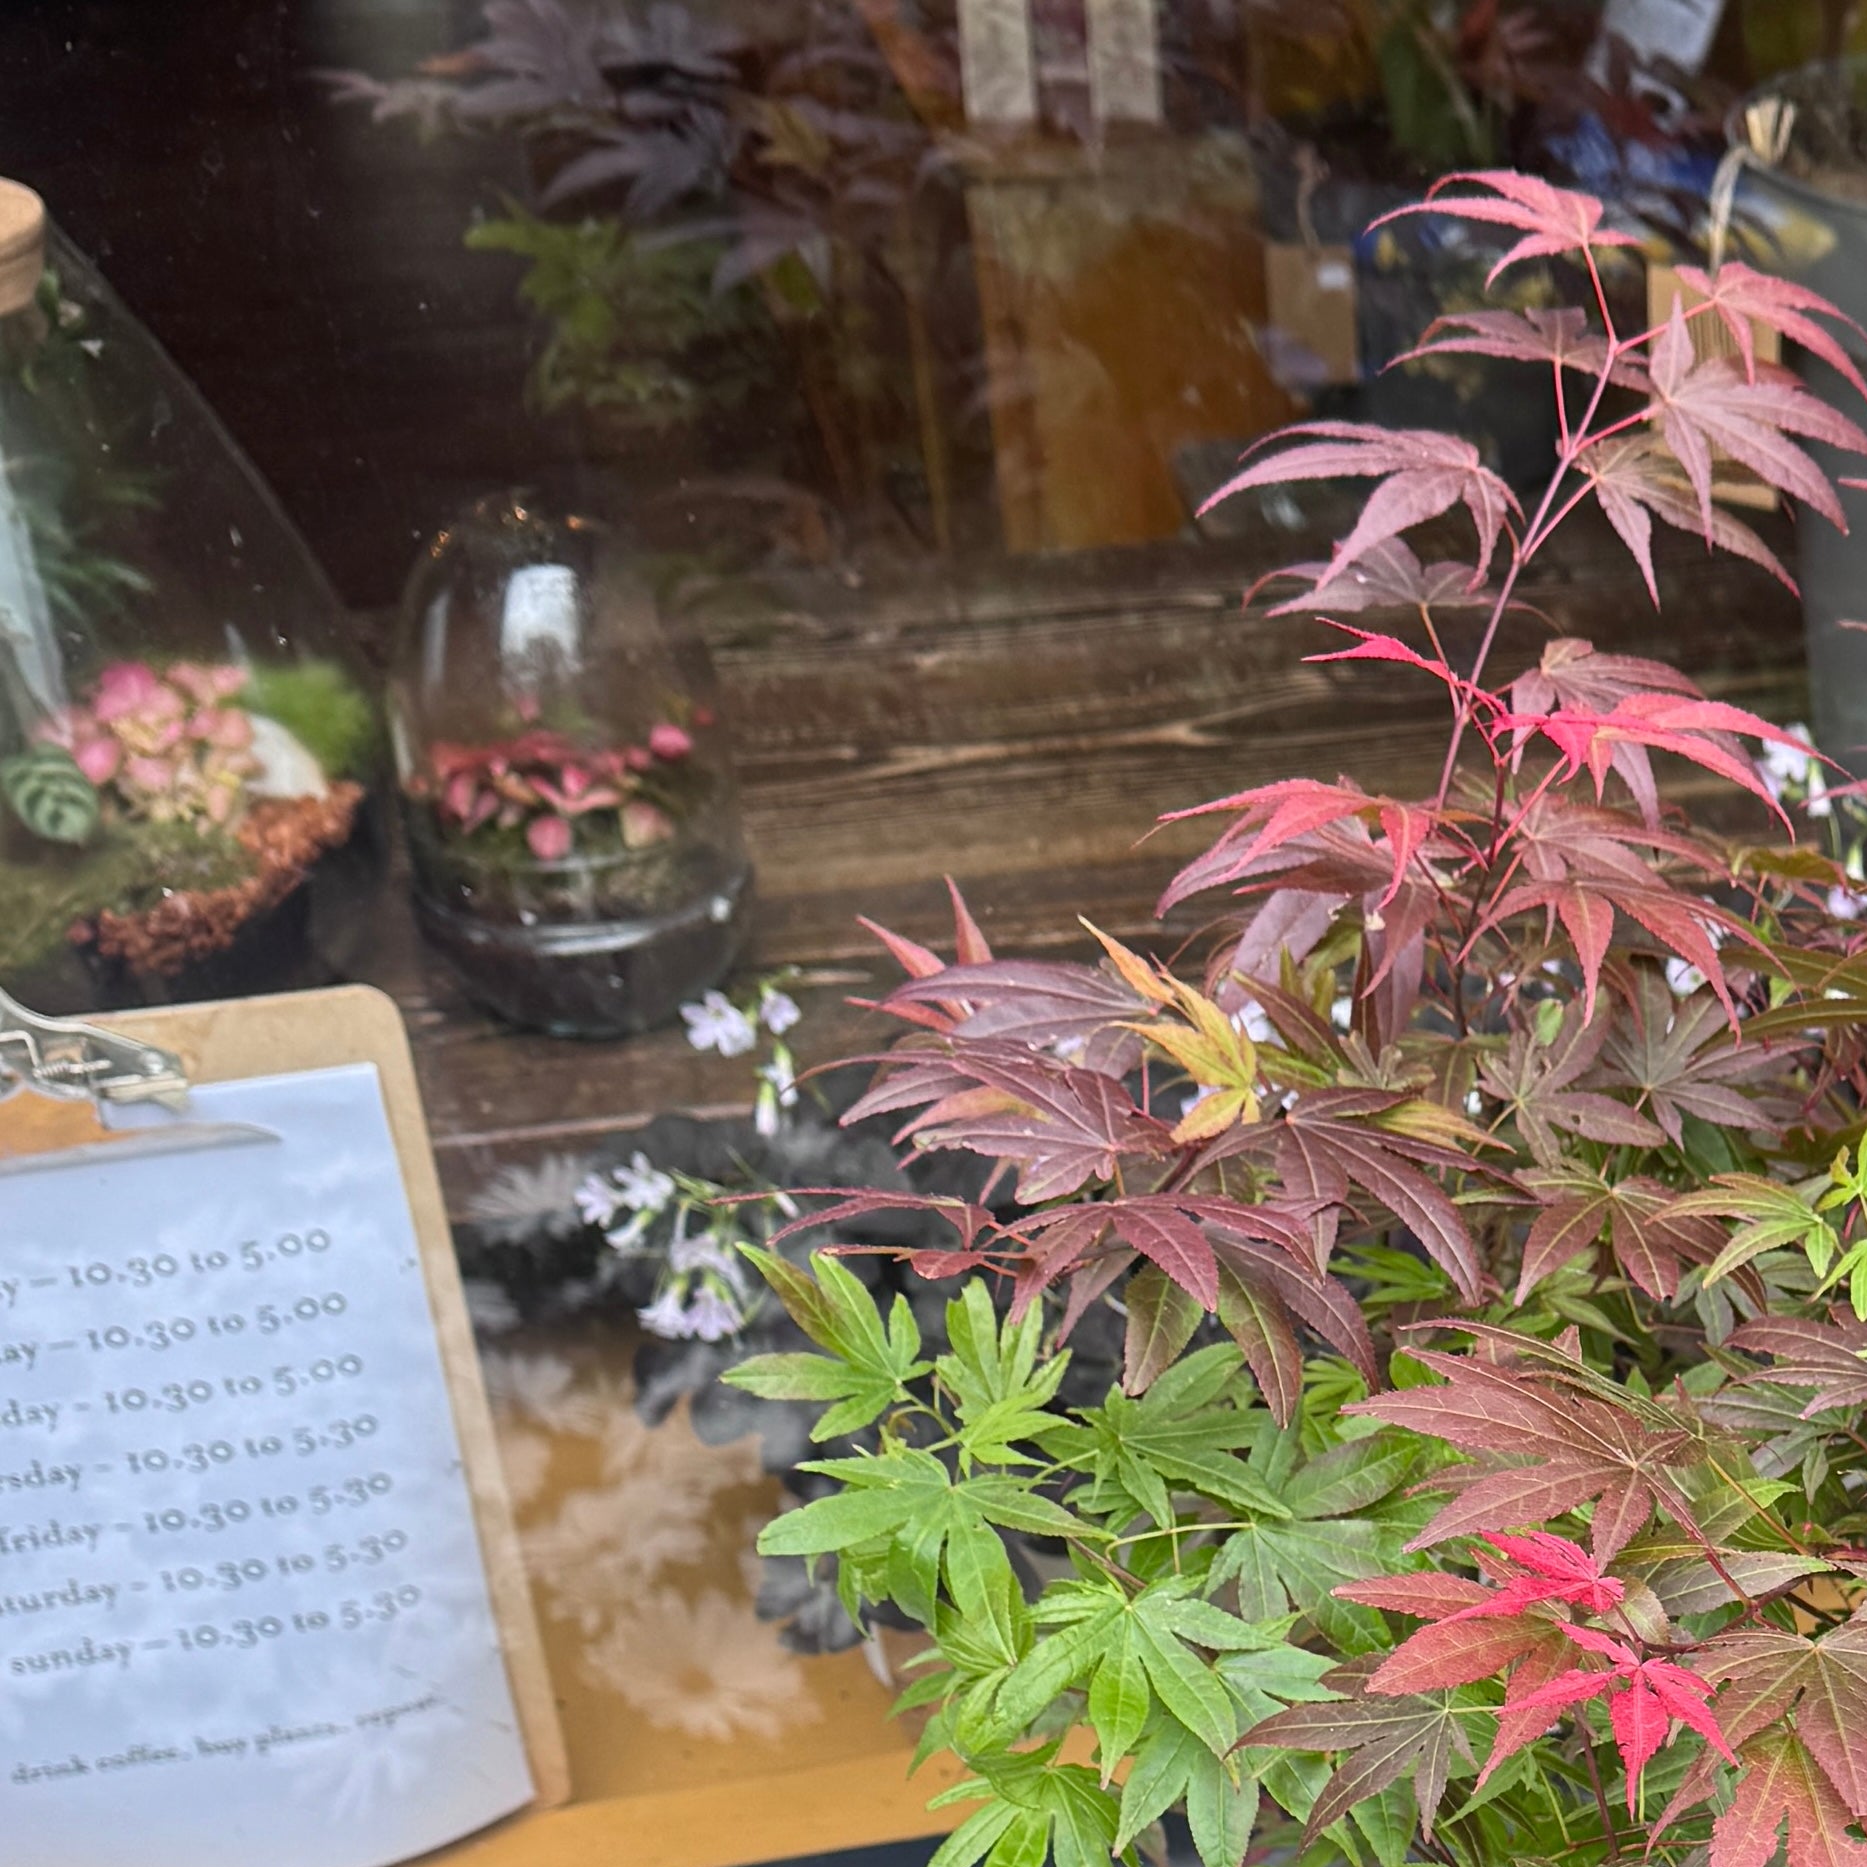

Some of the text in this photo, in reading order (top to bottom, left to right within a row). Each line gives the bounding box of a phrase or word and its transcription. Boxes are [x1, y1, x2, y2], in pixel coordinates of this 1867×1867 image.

[68, 1253, 180, 1288] 10.30
[190, 1249, 230, 1273] to
[239, 1228, 332, 1272] 5.00
[86, 1316, 198, 1352] 10.30
[207, 1312, 247, 1337] to
[257, 1292, 348, 1335] 5.00
[105, 1378, 214, 1414] 10.30
[223, 1375, 263, 1398] to
[273, 1353, 364, 1397] 5.00
[127, 1438, 237, 1474] 10.30
[245, 1435, 284, 1459] to
[293, 1413, 379, 1457] 5.30
[144, 1499, 252, 1534] 10.30
[260, 1495, 300, 1518] to
[309, 1471, 393, 1516] 5.30
[160, 1557, 269, 1592] 10.30
[276, 1553, 316, 1576] to
[324, 1528, 410, 1573] 5.30
[10, 1636, 133, 1676] sunday
[175, 1615, 284, 1650] 10.30
[291, 1610, 331, 1634] to
[339, 1583, 422, 1630] 5.30
